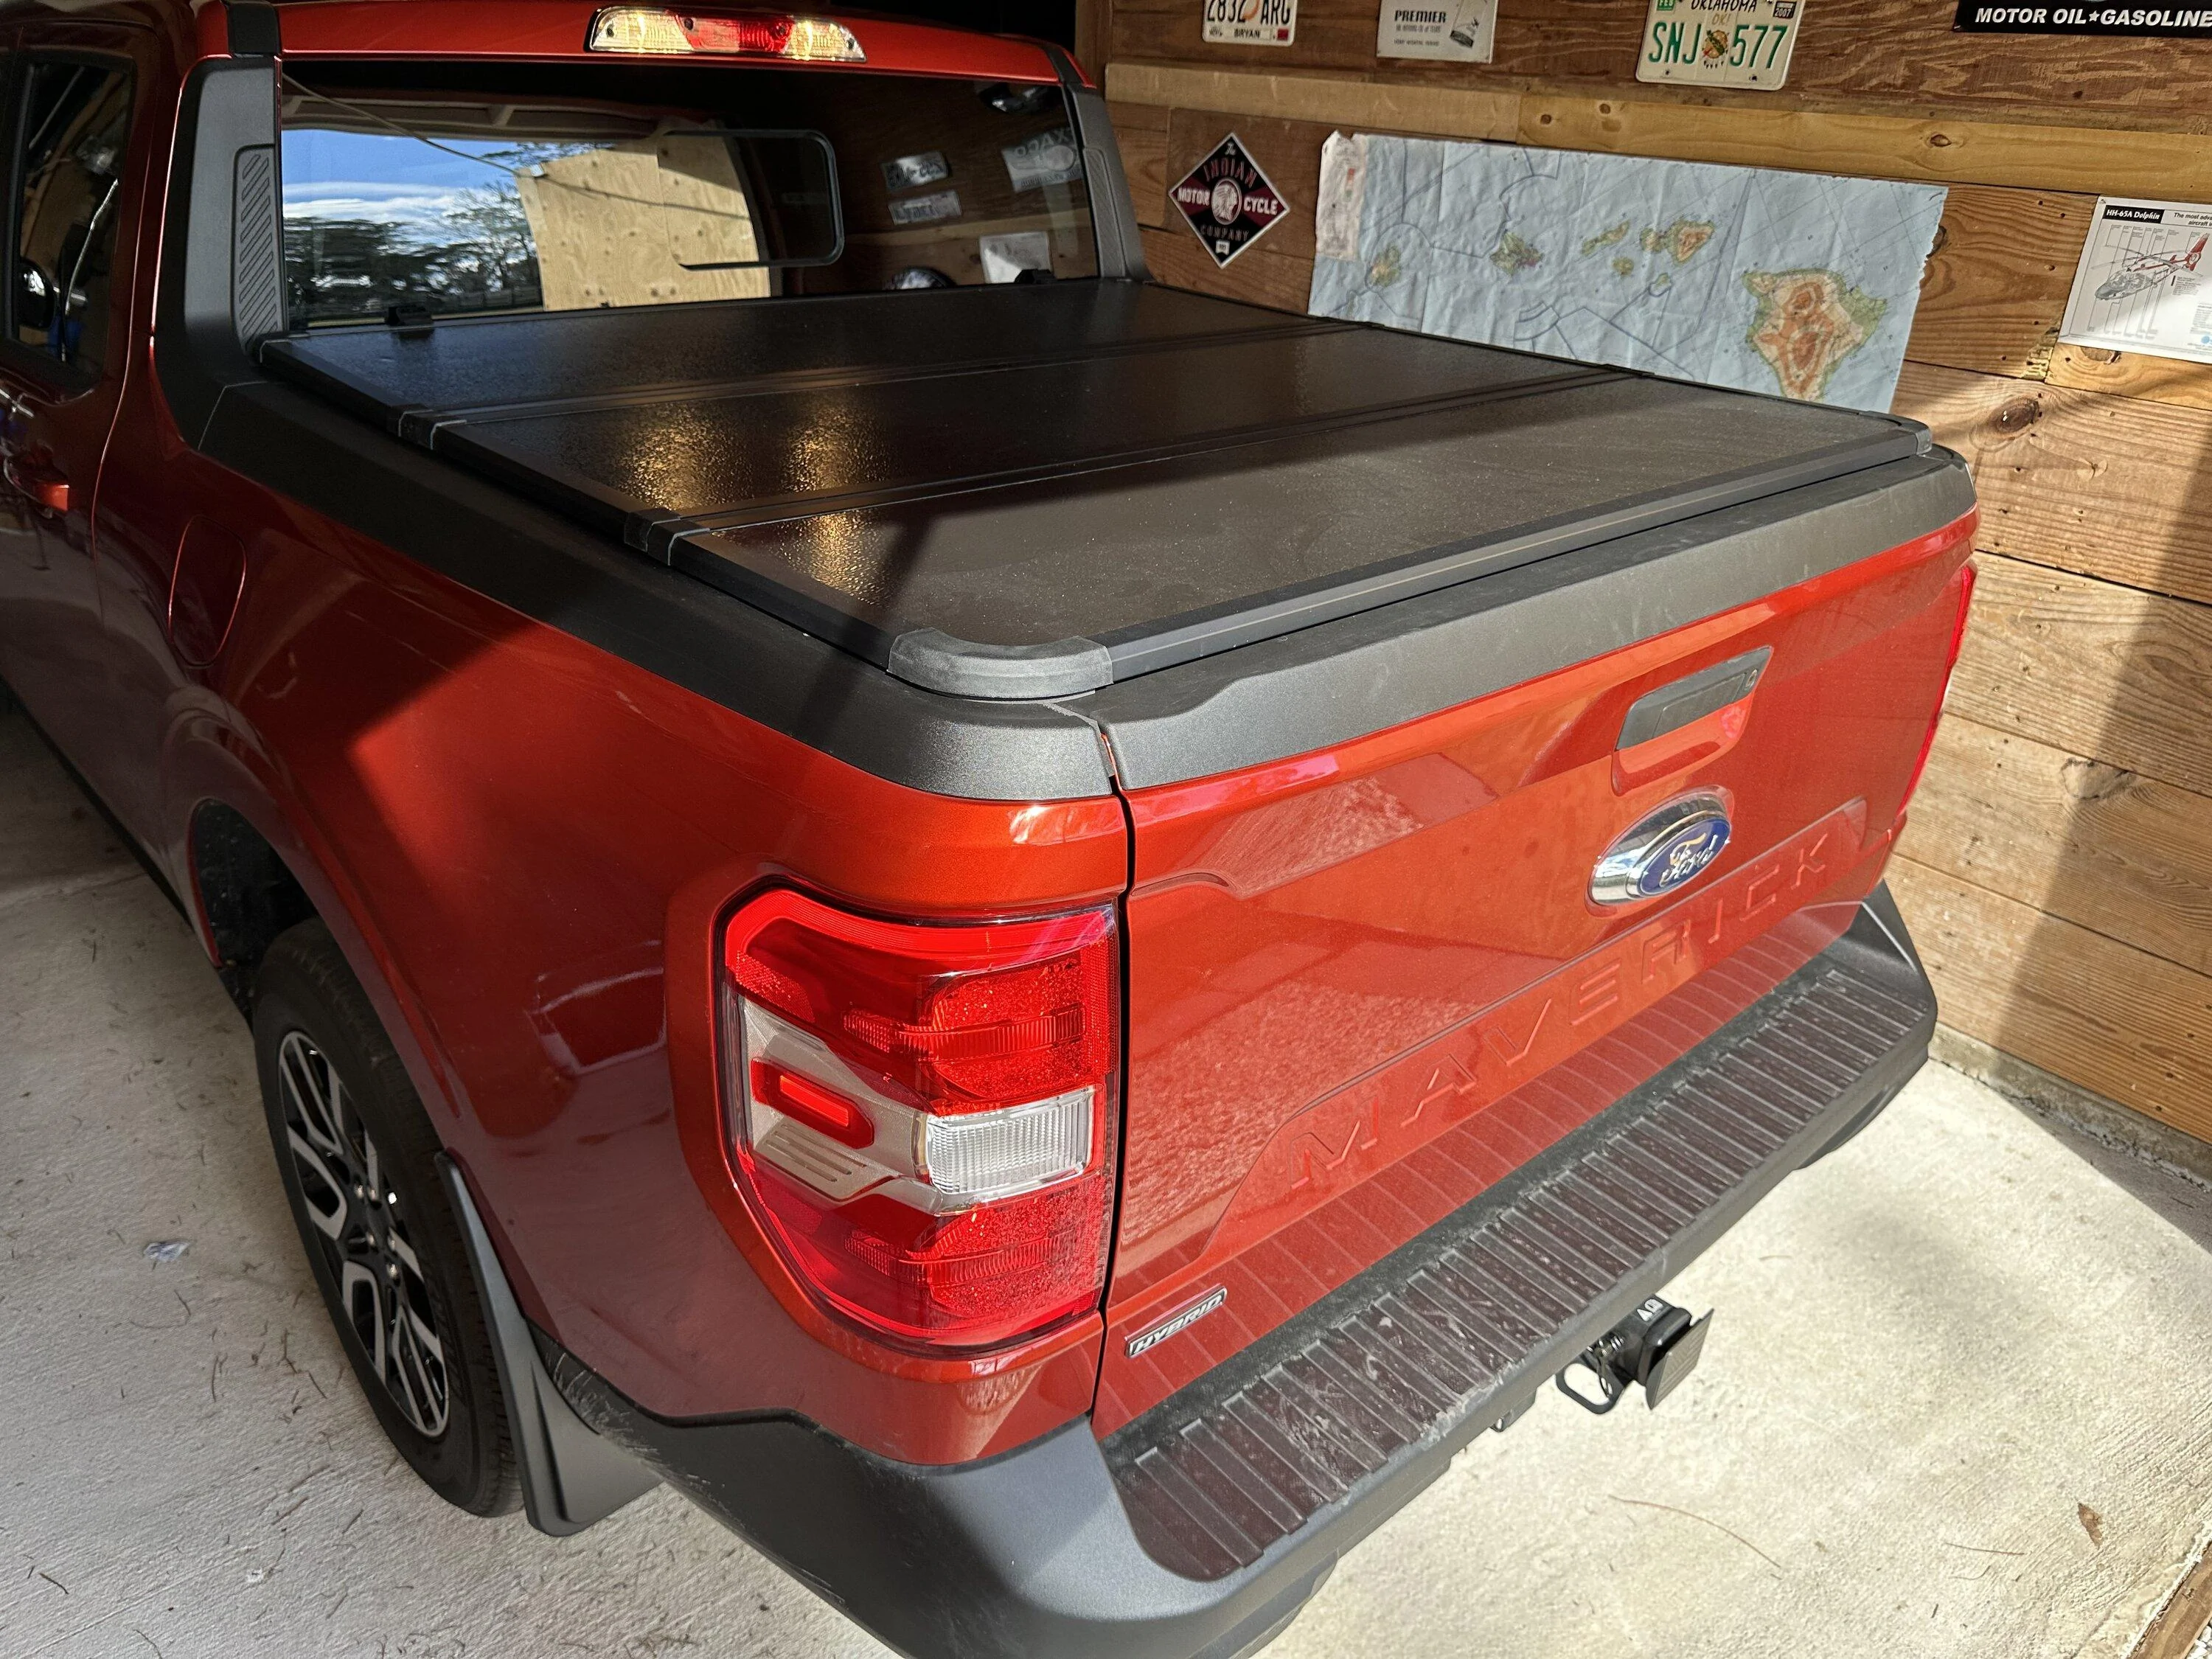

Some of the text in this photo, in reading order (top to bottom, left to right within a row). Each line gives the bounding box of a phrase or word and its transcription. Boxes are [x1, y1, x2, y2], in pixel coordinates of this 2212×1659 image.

[1394, 10, 1447, 23] PREMIER
[1691, 0, 1757, 13] OKLAHOMA
[1975, 8, 2212, 27] MOTOR OIL GASOLINE
[1234, 28, 1260, 38] BRYAN
[1648, 21, 1788, 69] SNJ 577
[1203, 158, 1257, 188] INDIAN
[1178, 187, 1279, 215] MOTOR CYCLE
[2106, 209, 2160, 220] HH-65A Dolphin
[1200, 223, 1250, 242] COMPANY
[1660, 832, 1719, 888] Ford
[1289, 833, 1829, 1189] MAVERICK
[1133, 1294, 1222, 1354] HYBRID
